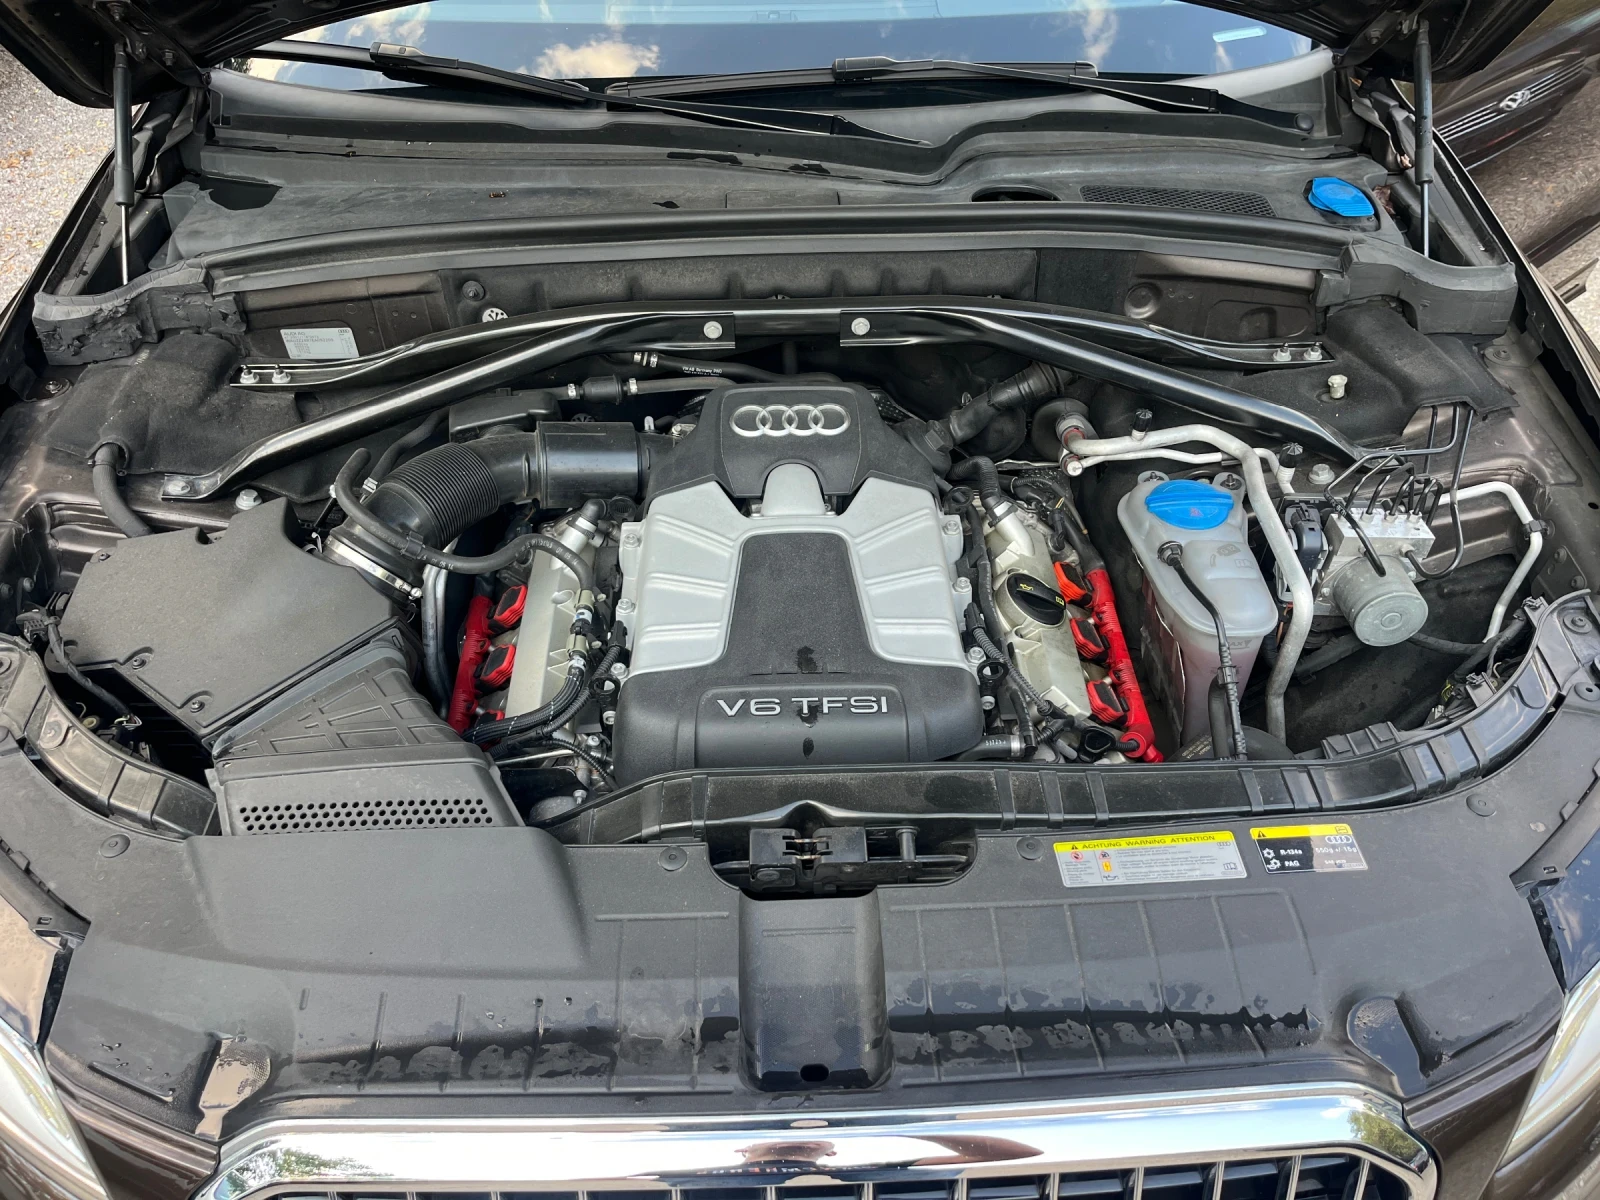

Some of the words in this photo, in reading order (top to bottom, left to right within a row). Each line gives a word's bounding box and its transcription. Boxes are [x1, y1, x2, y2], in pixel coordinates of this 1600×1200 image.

[717, 698, 781, 716] V6
[791, 696, 888, 714] TFSI
[1170, 835, 1215, 843] ATTENTION
